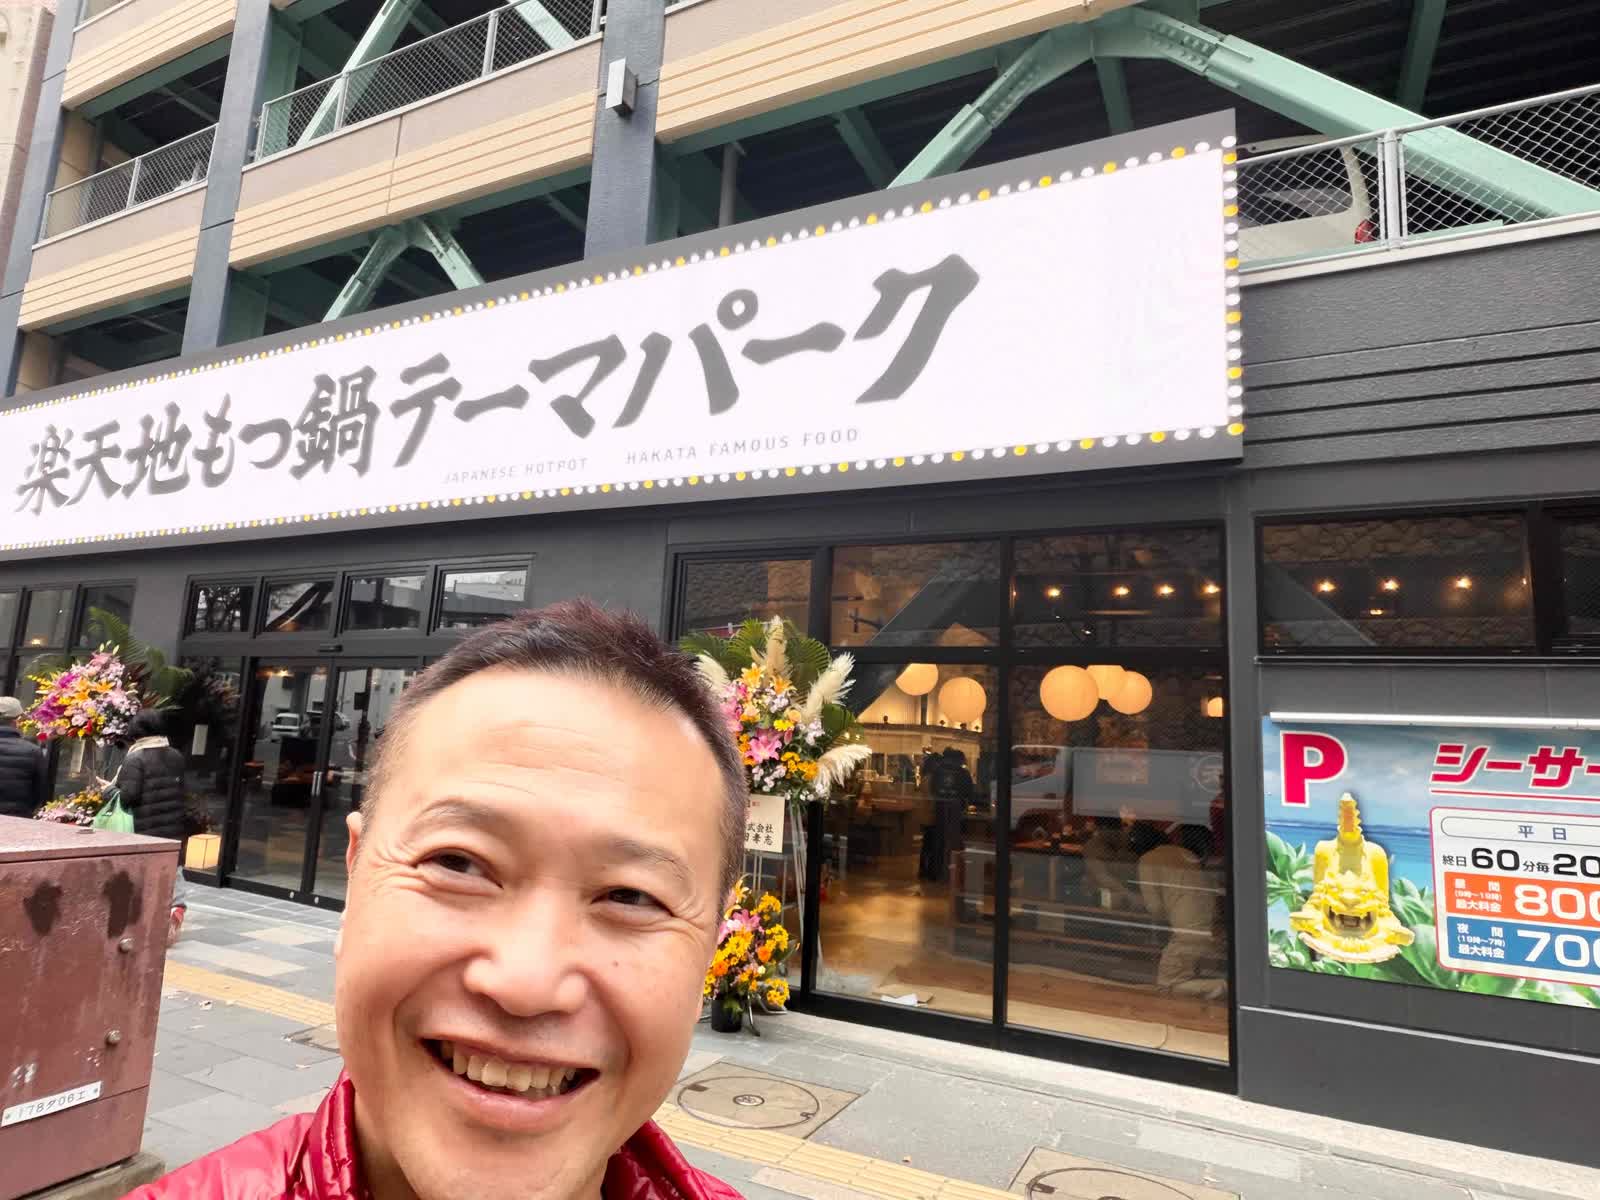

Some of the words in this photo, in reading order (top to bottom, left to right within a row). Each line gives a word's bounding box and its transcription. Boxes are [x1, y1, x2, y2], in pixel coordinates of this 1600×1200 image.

[15, 253, 980, 515] 楽天地もつ鍋テーマパーク
[625, 446, 697, 464] HAKATA
[709, 435, 790, 457] FAMOUS
[803, 428, 859, 446] FOOD
[443, 465, 515, 484] JAPANESE
[525, 458, 588, 475] HOTPOT
[1281, 731, 1347, 806] P
[1517, 929, 1600, 969] 70
